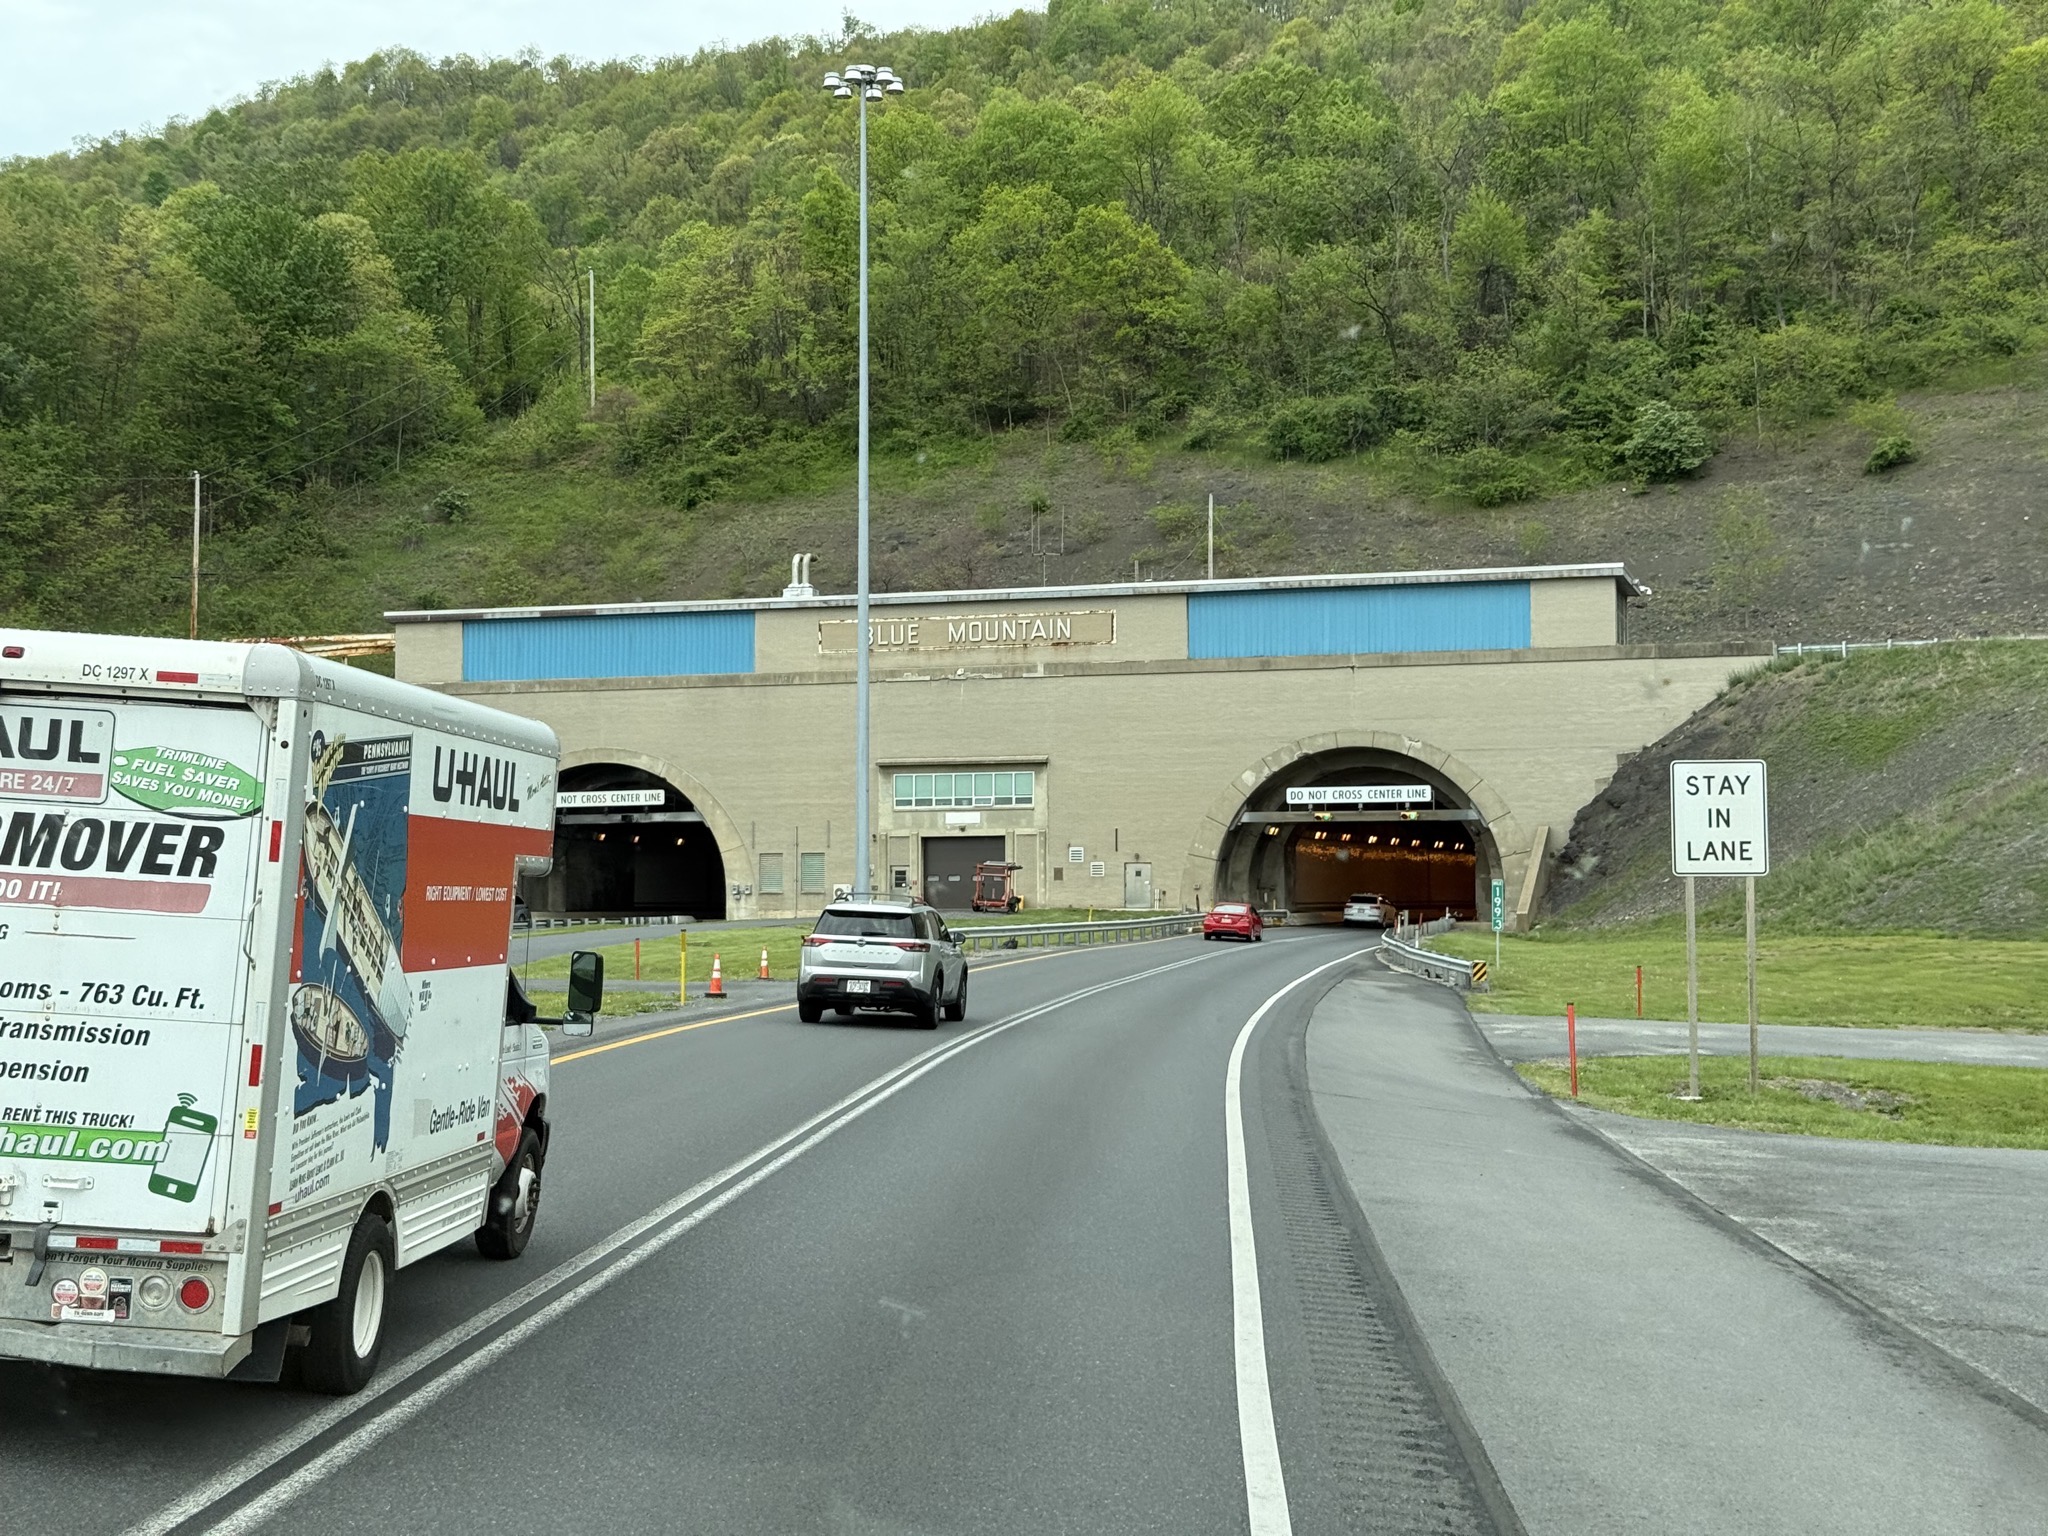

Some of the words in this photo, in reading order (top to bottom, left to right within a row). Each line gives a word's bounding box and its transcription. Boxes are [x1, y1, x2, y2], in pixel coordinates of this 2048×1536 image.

[949, 617, 1072, 643] MOUNTAIN
[82, 663, 102, 678] DC
[106, 666, 136, 680] 1297
[139, 667, 149, 681] X
[155, 746, 228, 771] TRIMLINE
[363, 740, 410, 760] PENNSYLVANIA
[131, 758, 176, 778] FUEL
[31, 774, 76, 793] 24/7
[112, 771, 160, 791] SAVES
[163, 781, 196, 798] YOU
[196, 788, 254, 810] MONEY
[1290, 790, 1304, 801] DO
[1308, 790, 1327, 800] NOT
[1332, 789, 1363, 800] CROSS
[1367, 788, 1402, 799] CENTER
[1407, 788, 1427, 799] LINE
[1686, 775, 1751, 796] STAY
[560, 794, 577, 805] NOT
[581, 793, 607, 804] CROSS
[611, 793, 641, 803] CENTER
[644, 792, 662, 802] LINE
[1707, 807, 1731, 829] IN
[0, 811, 226, 878] MOVER
[1687, 840, 1753, 862] LANE
[28, 880, 62, 901] IT!
[79, 982, 126, 1005] 763
[131, 985, 169, 1009] Cu.
[175, 987, 206, 1010] Ft.
[0, 1016, 151, 1047] ransmission
[2, 1106, 41, 1123] RENT
[45, 1109, 77, 1125] THIS
[81, 1111, 135, 1129] TRUCK!
[429, 1097, 476, 1135] Gentle-Ride
[477, 1094, 491, 1120] Van
[294, 1173, 331, 1204] uhaul.com
[45, 1252, 65, 1262] on't
[67, 1253, 100, 1265] Forget
[101, 1255, 124, 1266] Your
[126, 1257, 163, 1270] Moving
[165, 1259, 214, 1272] Supplies!
